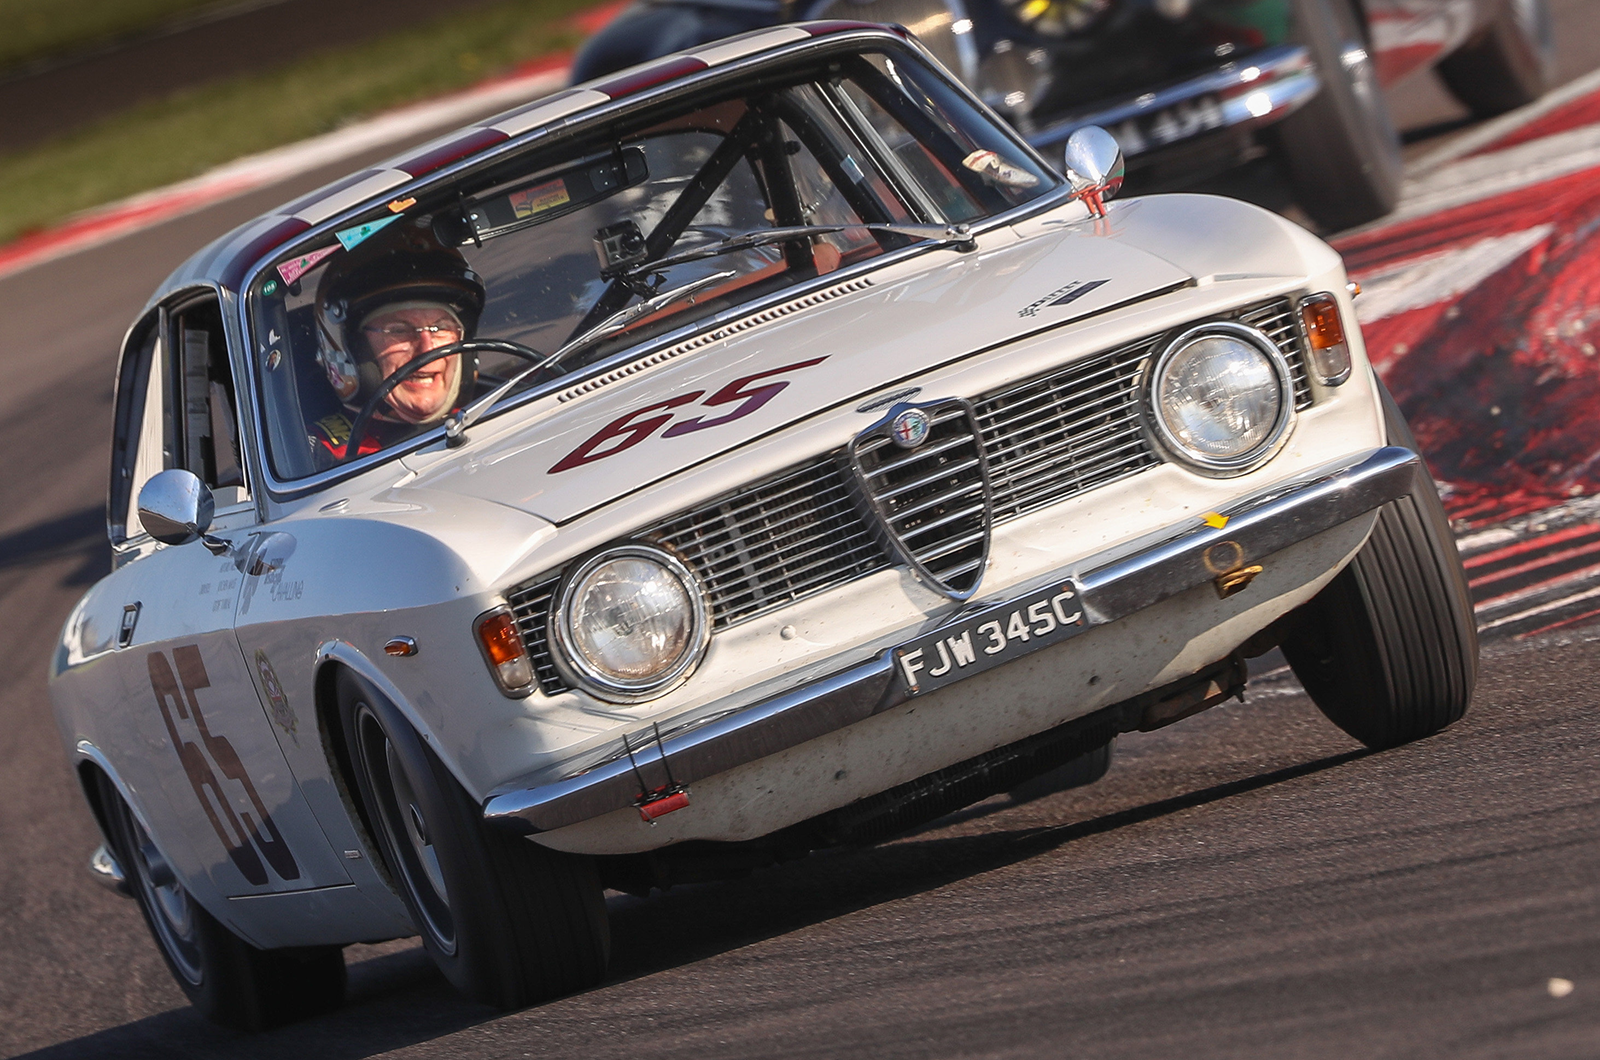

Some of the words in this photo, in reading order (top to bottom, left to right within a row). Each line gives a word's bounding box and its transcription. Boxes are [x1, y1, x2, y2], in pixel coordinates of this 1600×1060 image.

[547, 354, 833, 474] 65
[900, 629, 976, 688] FJW
[976, 591, 1083, 655] 345C
[147, 644, 301, 886] 65
